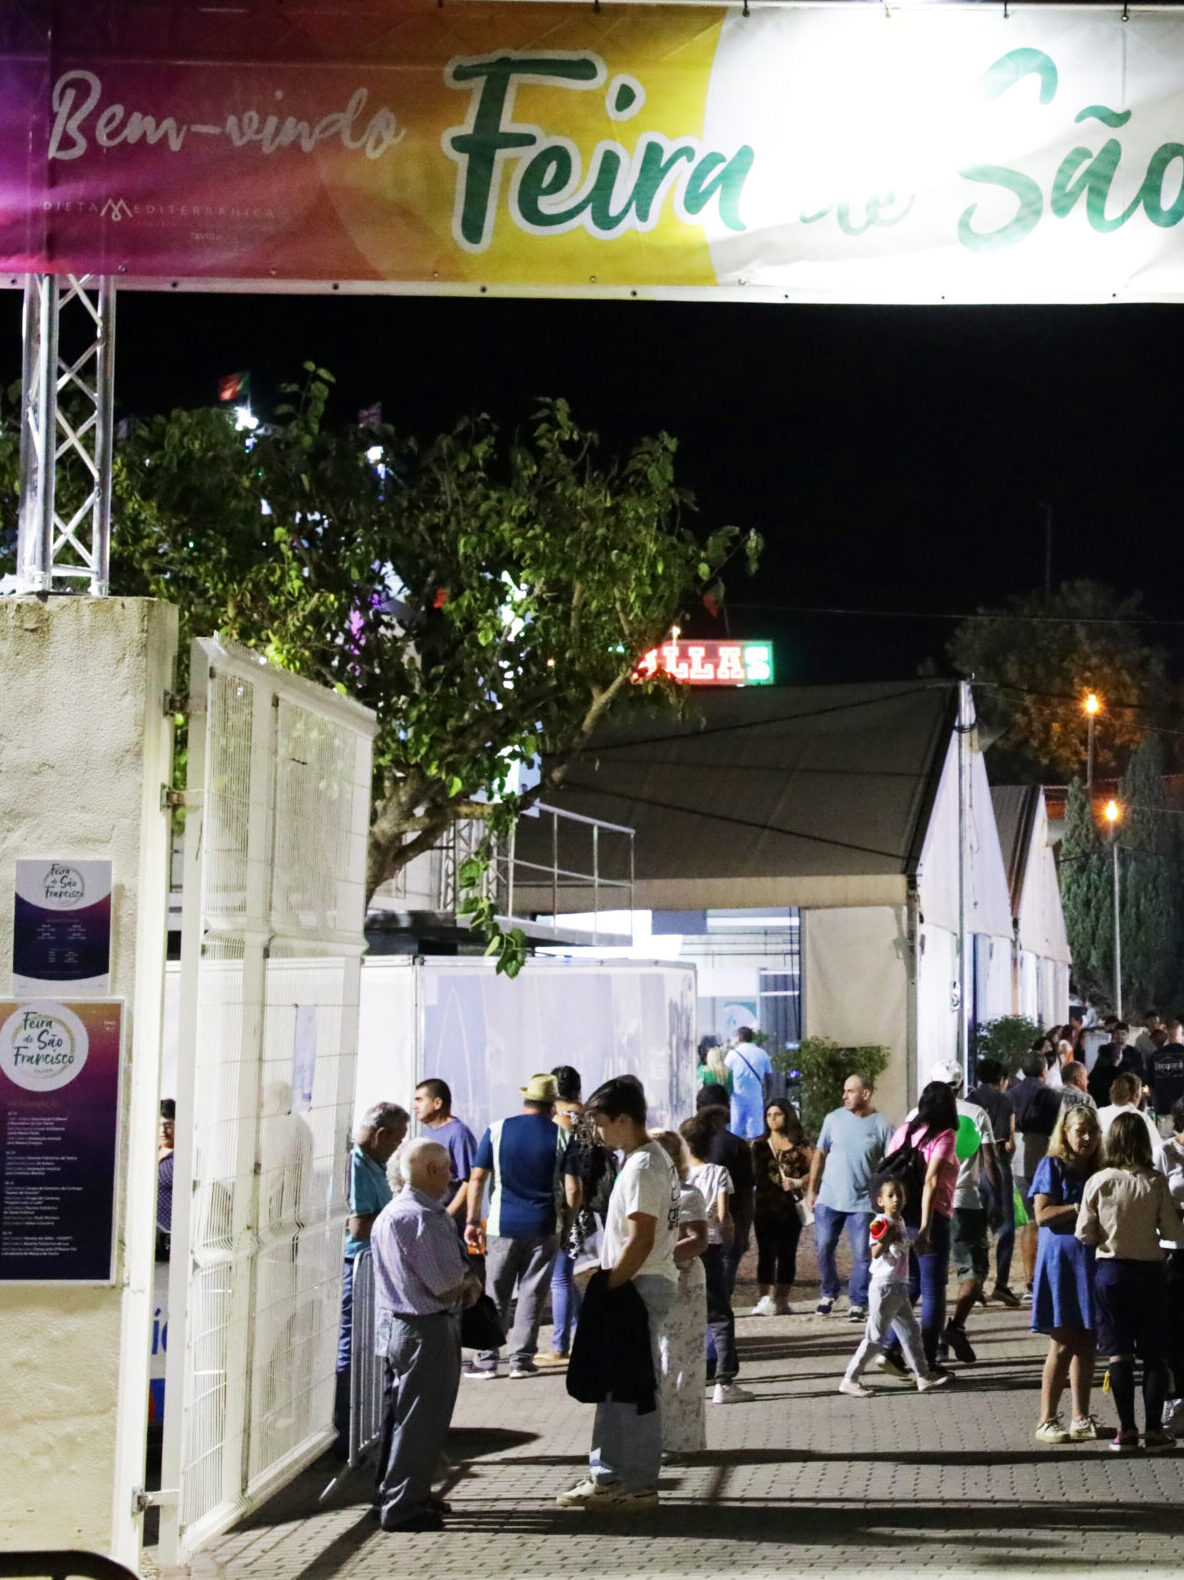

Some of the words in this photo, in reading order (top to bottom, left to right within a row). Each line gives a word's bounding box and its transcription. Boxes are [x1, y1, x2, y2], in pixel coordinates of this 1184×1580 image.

[48, 70, 407, 160] Bem-vindo
[449, 56, 756, 245] Feira
[50, 863, 71, 876] Feira
[45, 885, 84, 899] Francisco
[23, 1011, 53, 1030] Feira
[37, 1029, 63, 1050] São
[14, 1046, 75, 1066] Francisco
